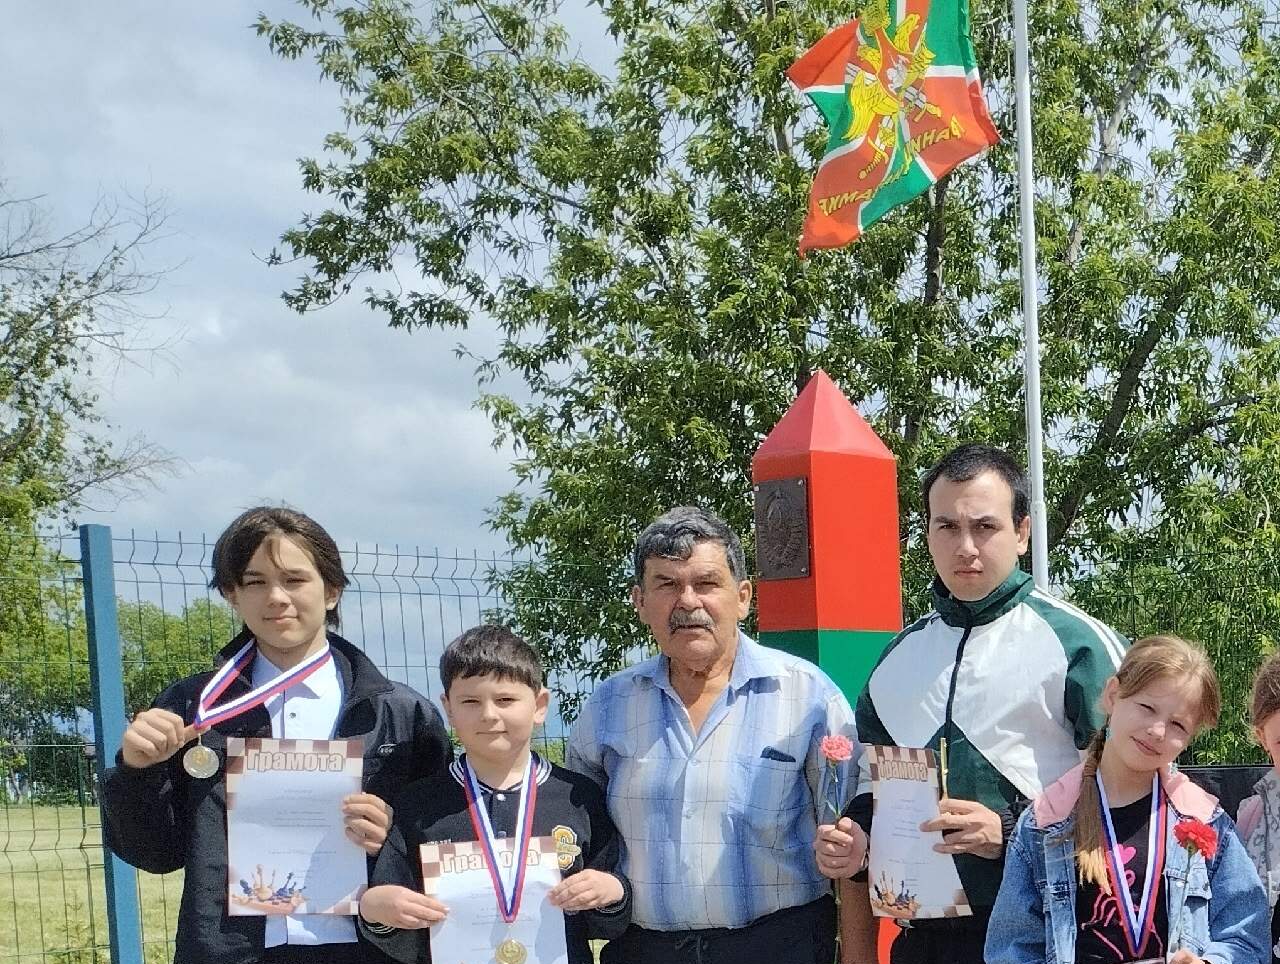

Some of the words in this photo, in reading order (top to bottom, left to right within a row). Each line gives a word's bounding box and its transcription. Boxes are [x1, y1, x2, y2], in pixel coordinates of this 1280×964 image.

[246, 749, 344, 772] Грамота
[878, 756, 928, 782] Грамота
[443, 849, 541, 874] Граоа
